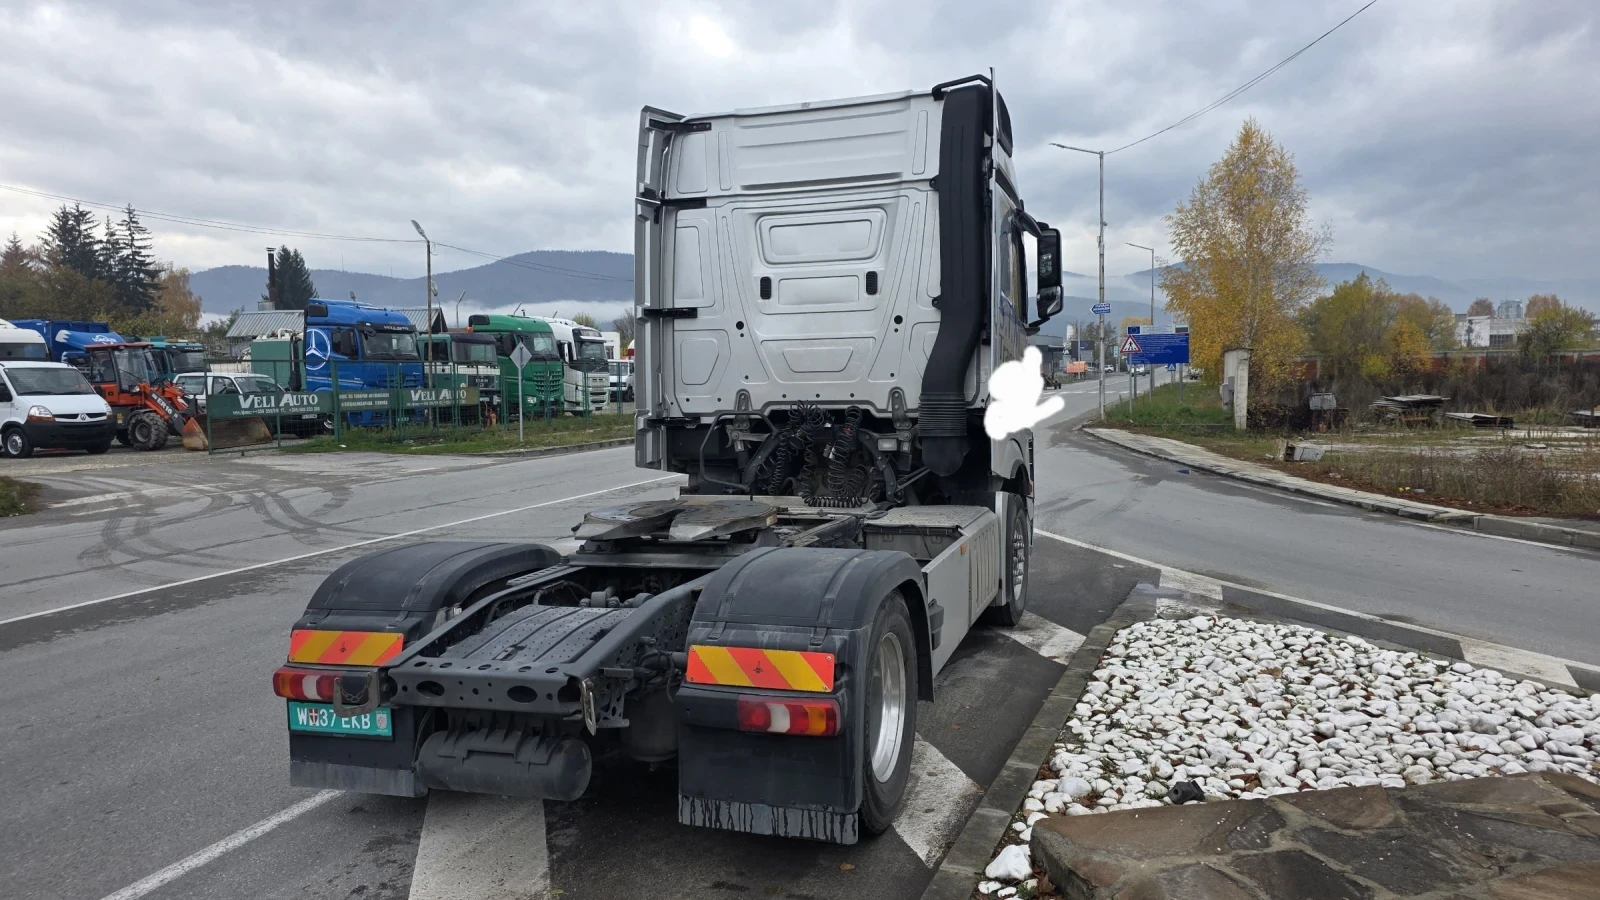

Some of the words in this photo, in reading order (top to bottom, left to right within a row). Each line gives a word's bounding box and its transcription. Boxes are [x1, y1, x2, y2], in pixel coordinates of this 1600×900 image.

[297, 707, 308, 726] W
[320, 708, 337, 728] 37
[341, 712, 371, 730] EKB
